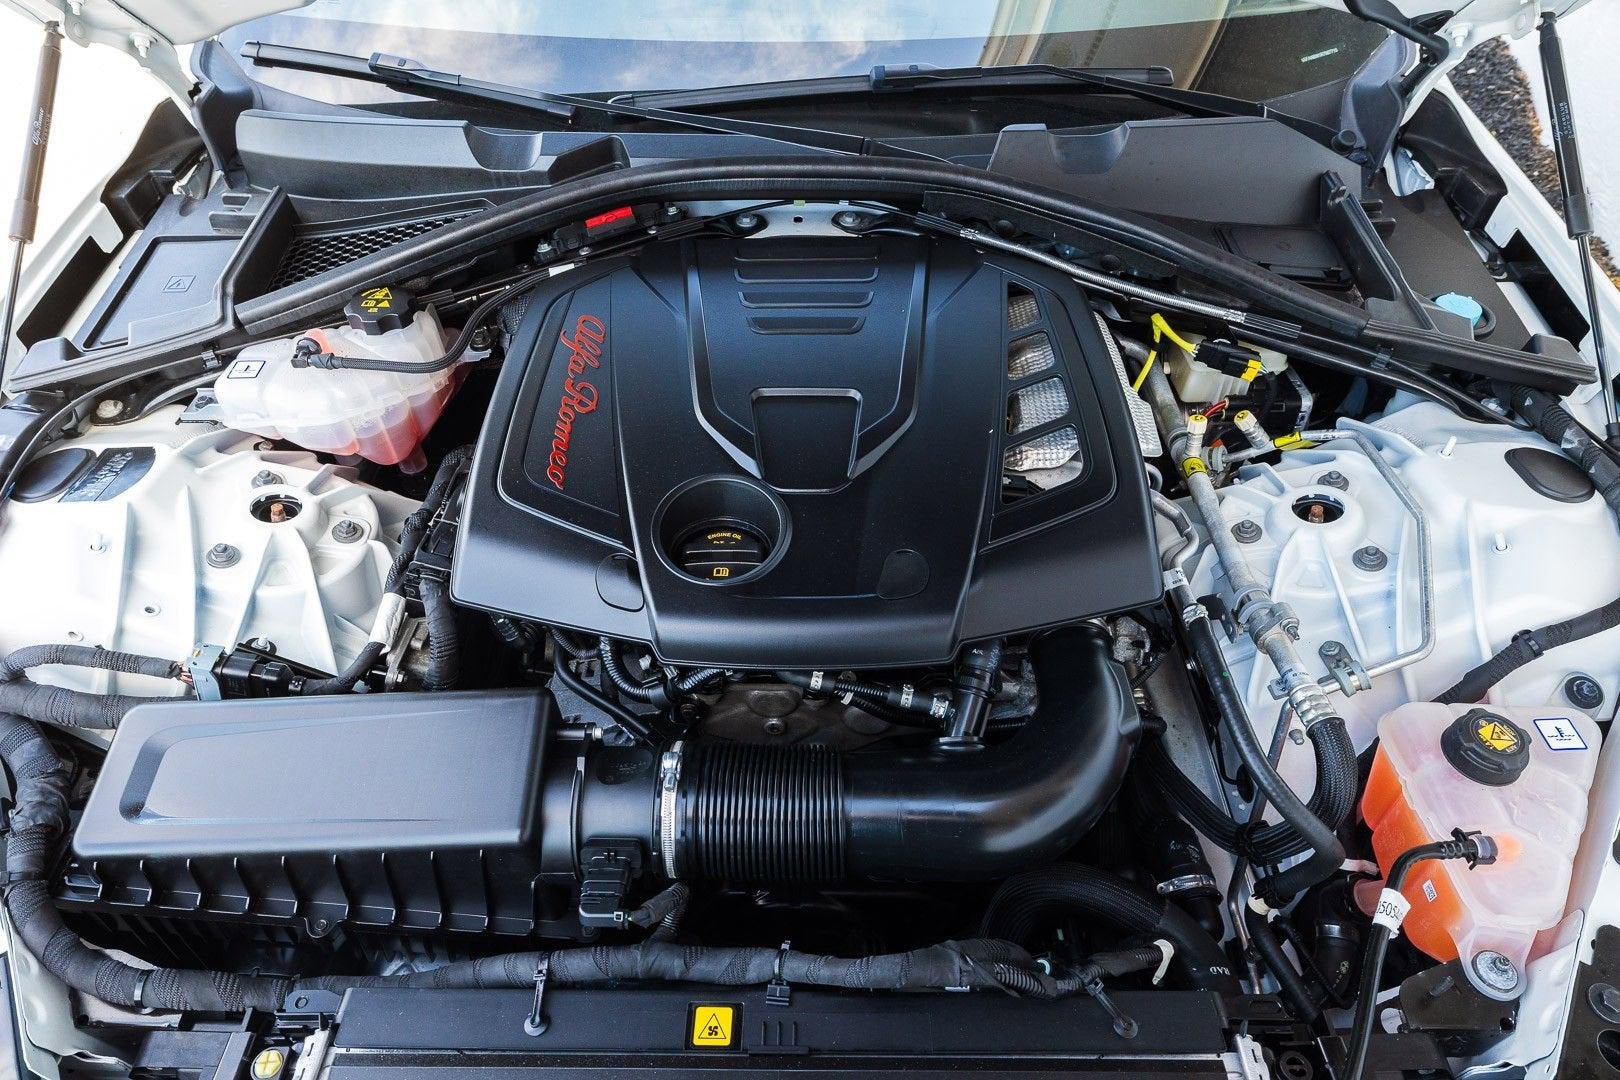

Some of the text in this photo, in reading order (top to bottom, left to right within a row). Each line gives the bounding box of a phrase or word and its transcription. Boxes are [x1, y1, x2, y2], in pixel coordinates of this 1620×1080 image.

[546, 313, 606, 491] Alfa Romeo
[707, 532, 742, 541] ENGINE OIL
[1209, 966, 1231, 976] RAD
